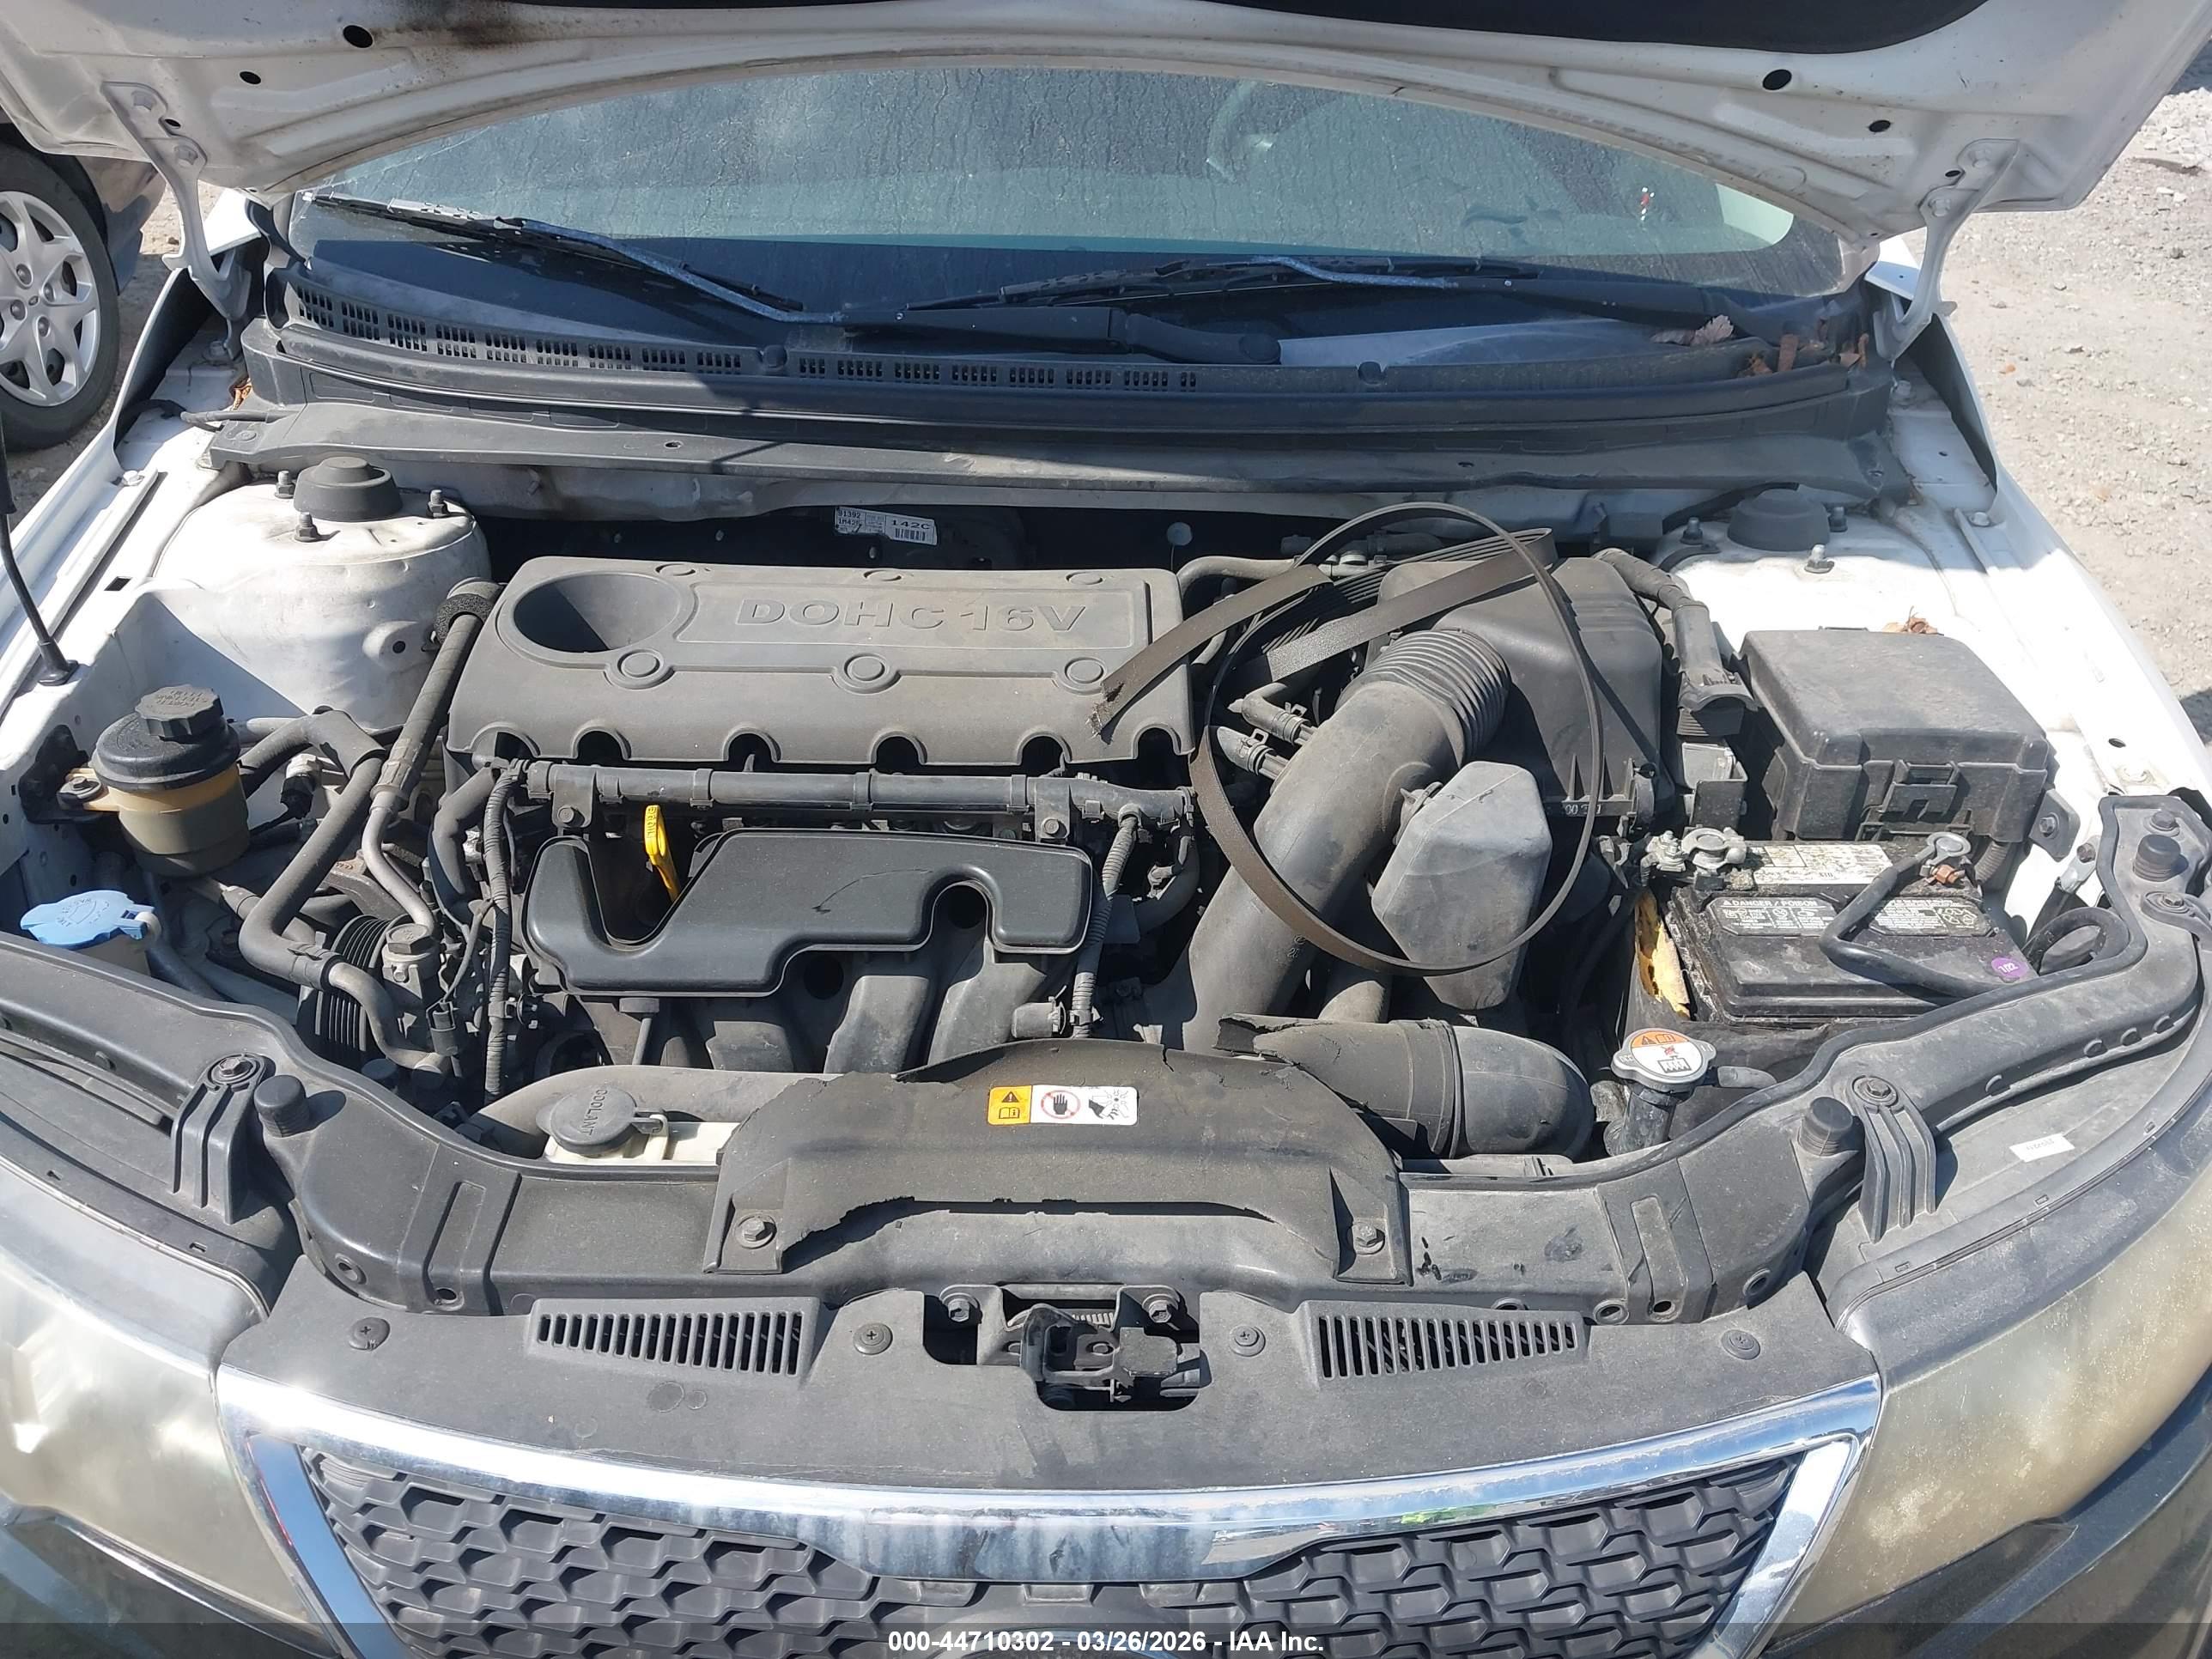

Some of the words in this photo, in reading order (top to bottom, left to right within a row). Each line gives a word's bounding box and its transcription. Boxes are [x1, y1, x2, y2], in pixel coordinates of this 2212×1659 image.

[892, 520, 932, 530] 142C
[736, 599, 945, 629] DOHC
[957, 604, 1087, 632] 16V
[580, 1089, 608, 1136] COOLANT
